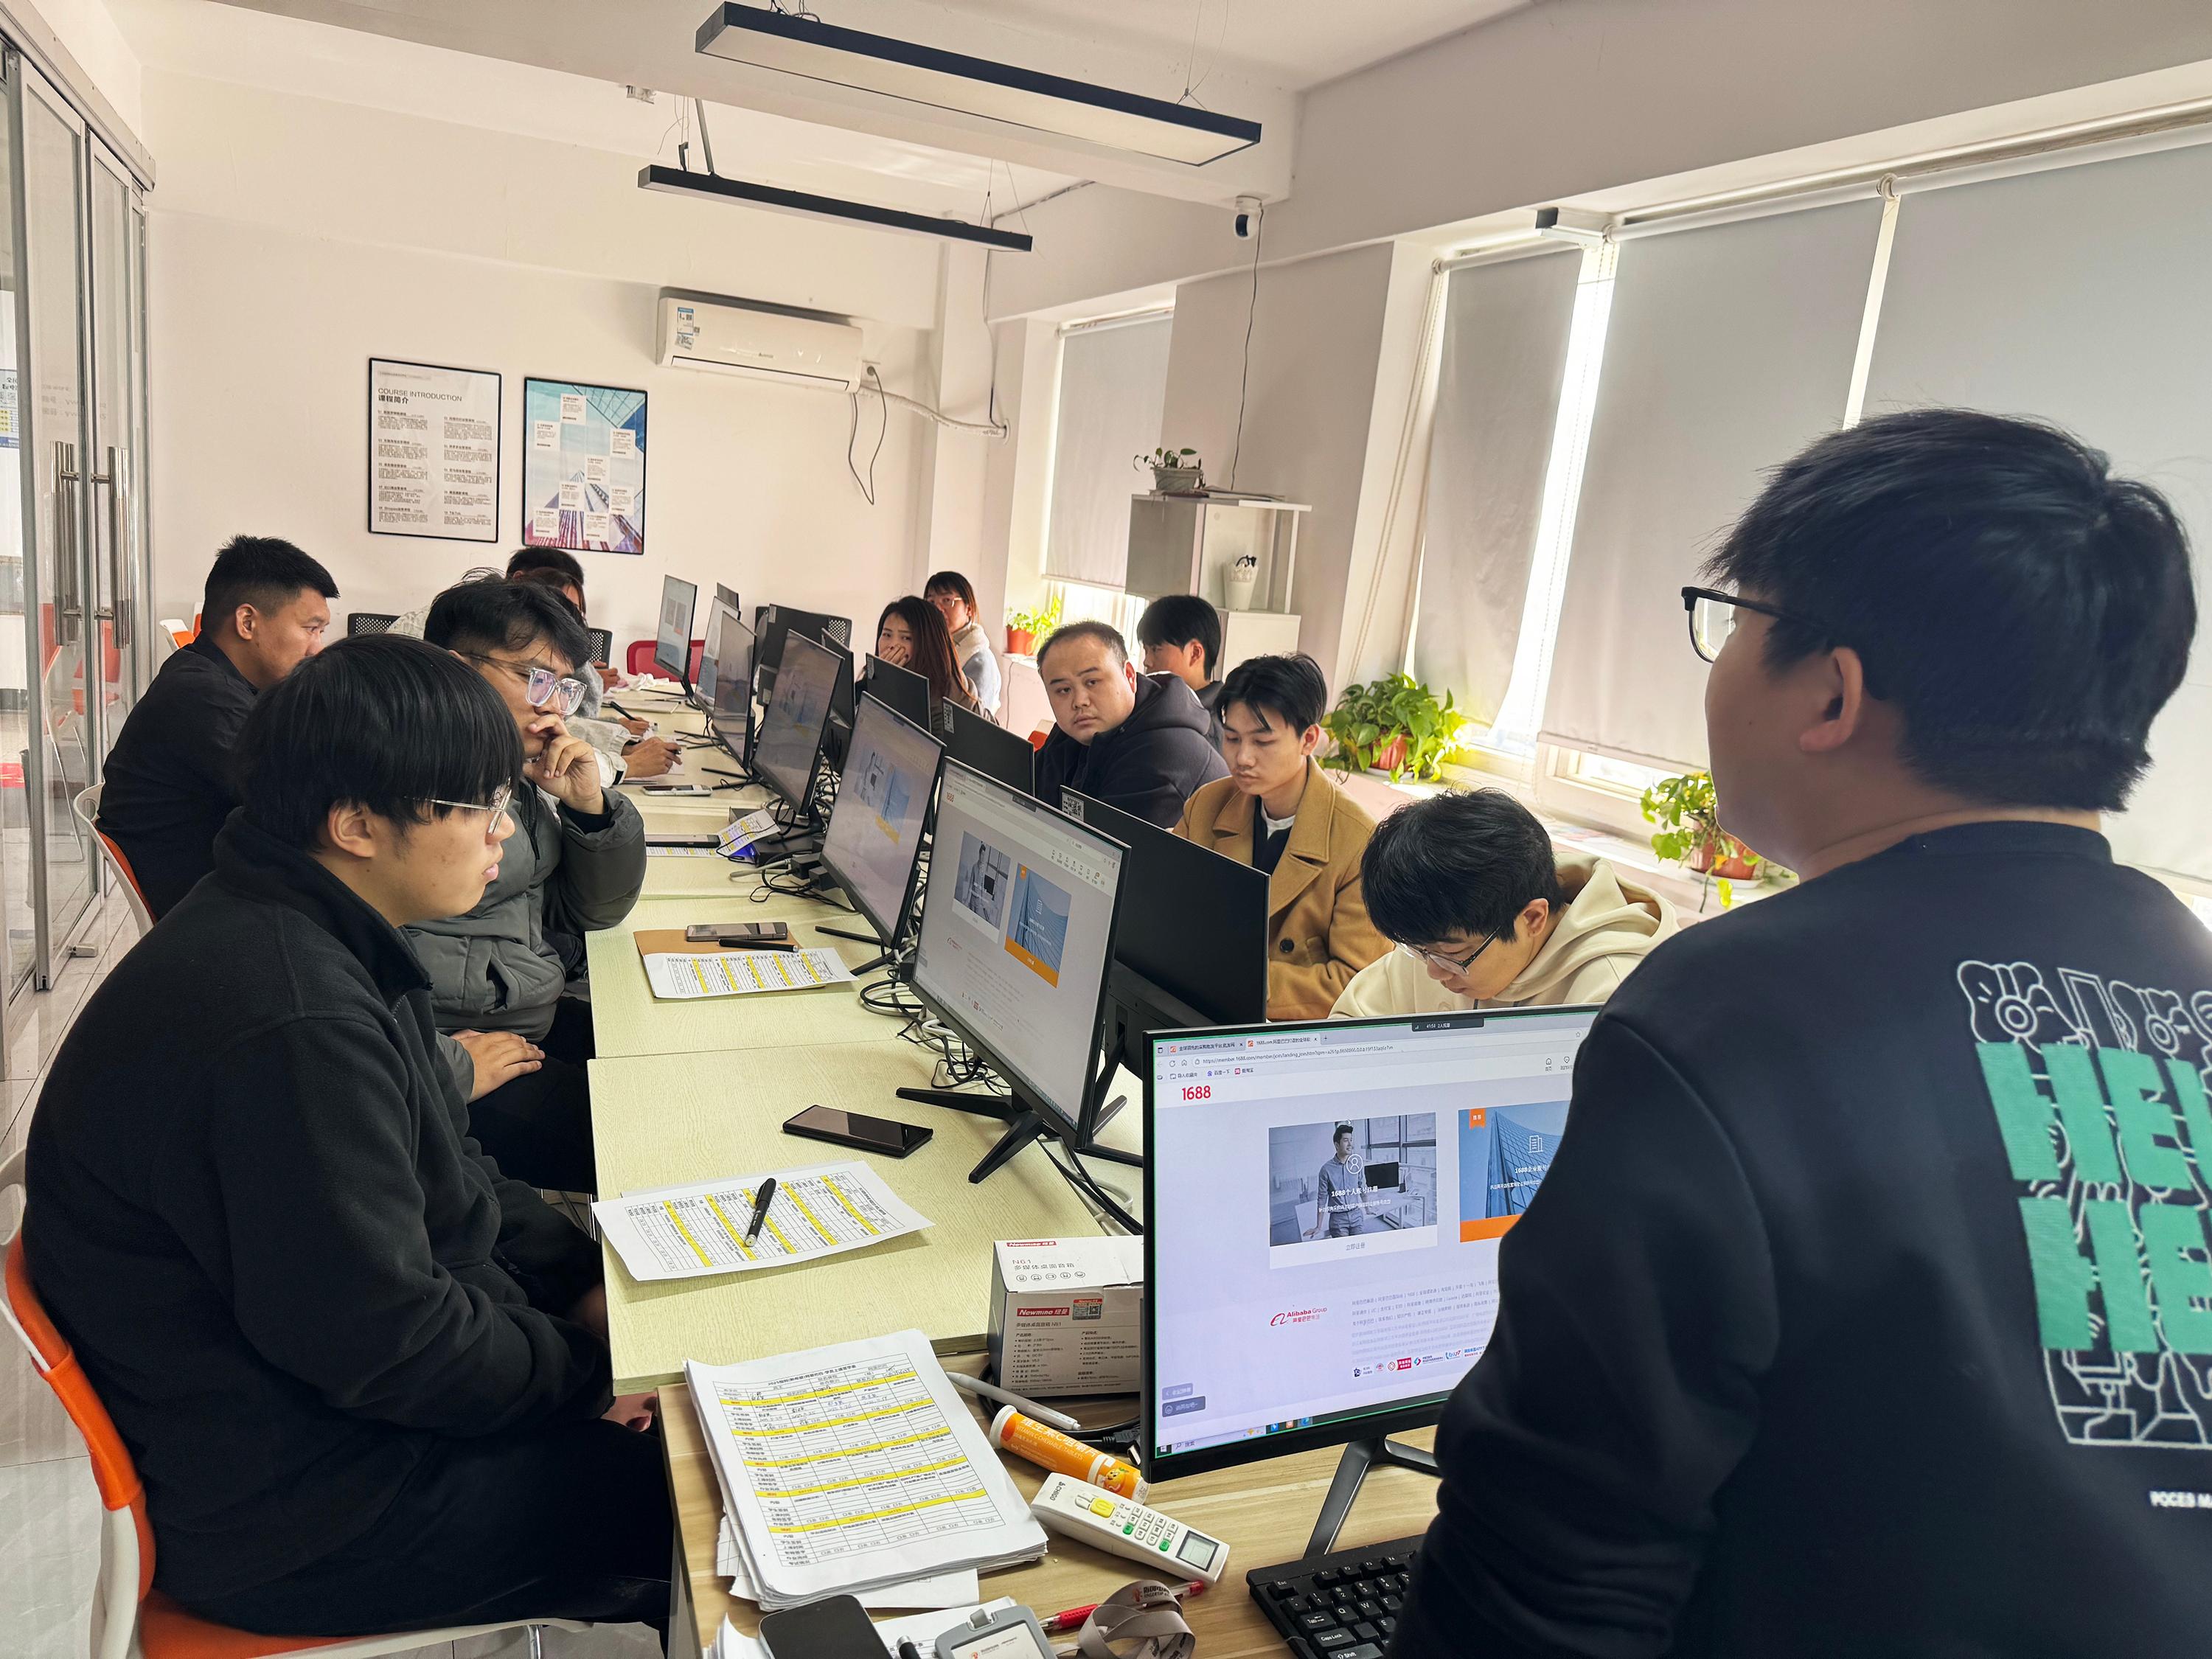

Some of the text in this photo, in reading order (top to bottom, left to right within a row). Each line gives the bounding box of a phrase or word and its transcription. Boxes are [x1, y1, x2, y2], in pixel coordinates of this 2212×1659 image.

[378, 388, 462, 401] COURSE INTRODUCTION
[378, 394, 408, 404] 课程简介
[1182, 1085, 1211, 1101] 1688
[1287, 1310, 1311, 1318] Alibaba
[1022, 1418, 1101, 1457] 维生素C咀嚼片
[1050, 1485, 1062, 1500] CHIGO
